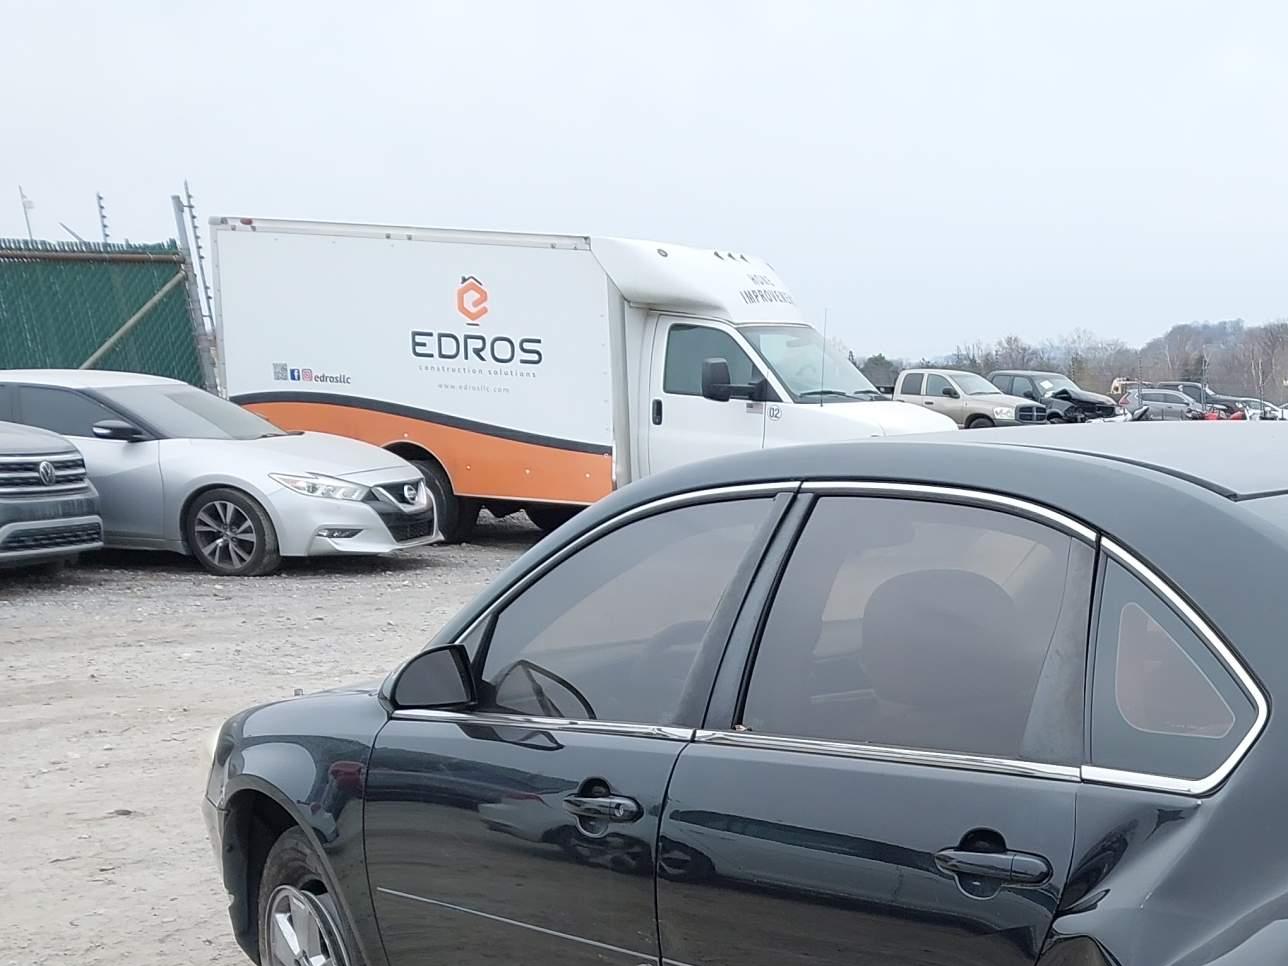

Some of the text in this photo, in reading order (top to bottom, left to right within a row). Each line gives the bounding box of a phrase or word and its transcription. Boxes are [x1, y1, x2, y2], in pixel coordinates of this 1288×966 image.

[411, 331, 543, 365] EDROS
[418, 364, 537, 378] construction solutions
[314, 373, 351, 384] edrosllc
